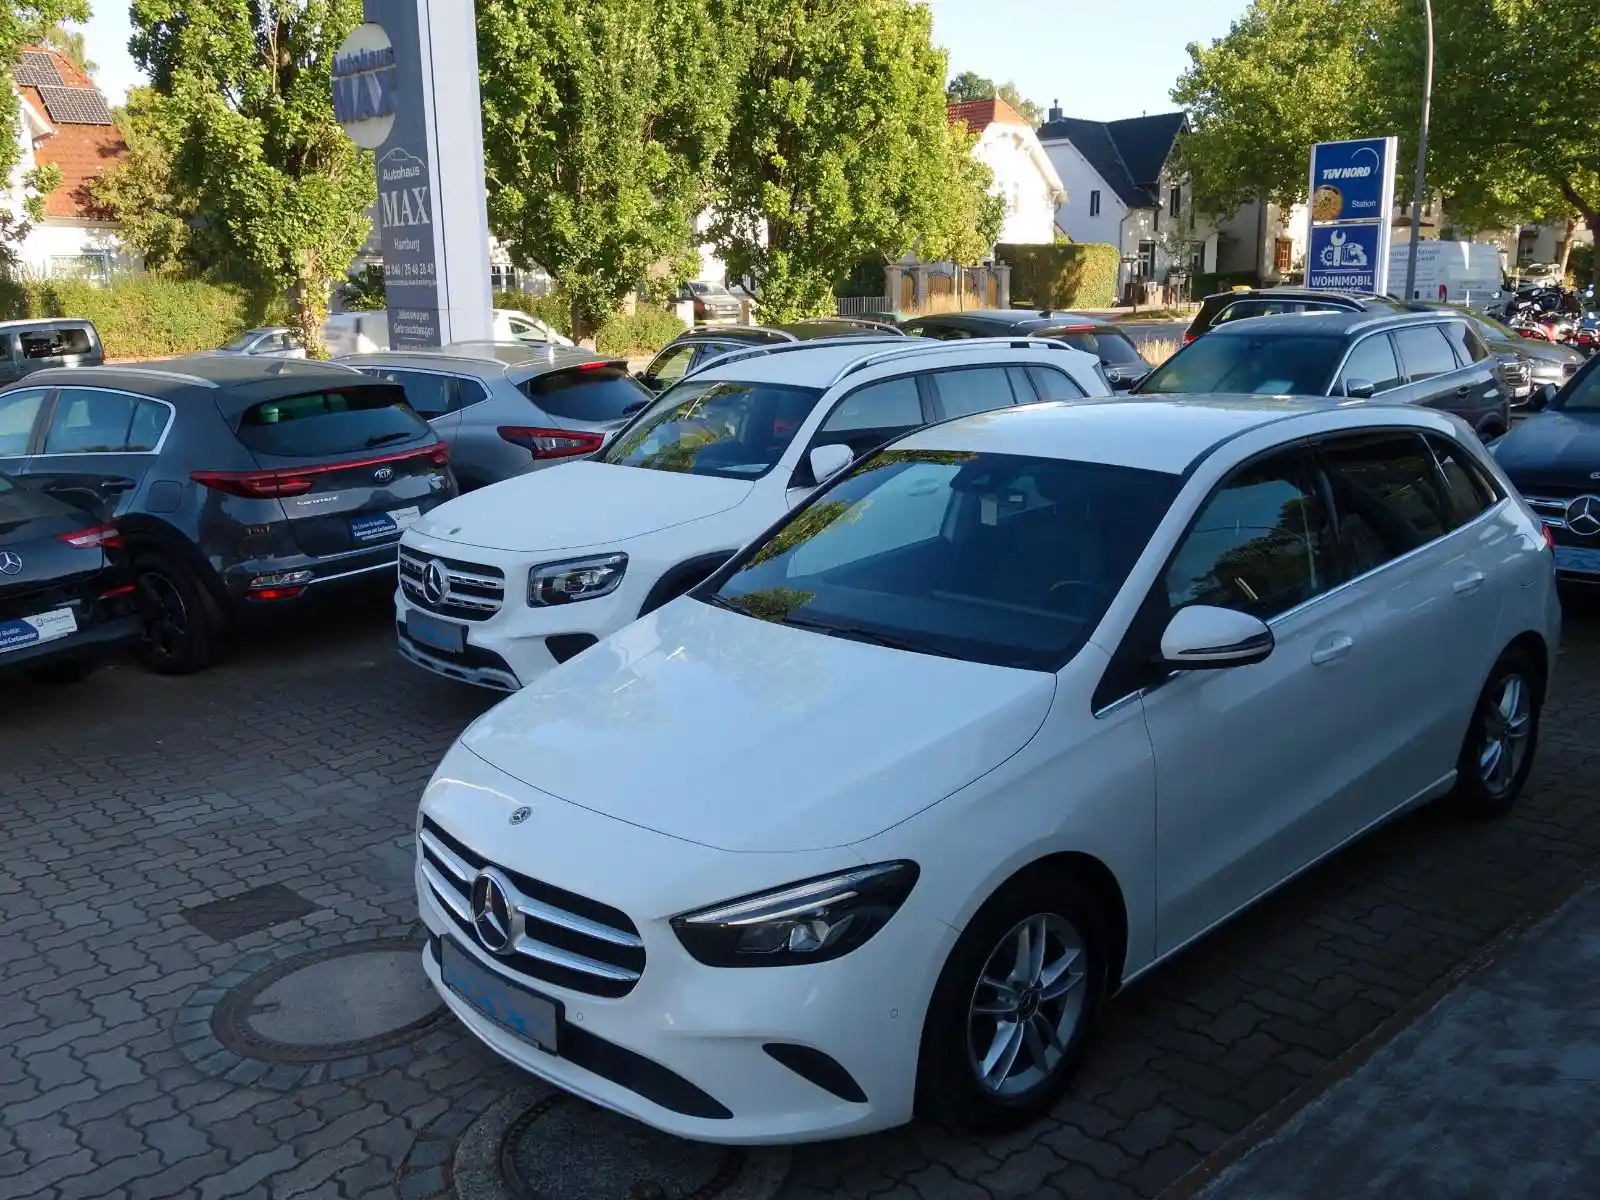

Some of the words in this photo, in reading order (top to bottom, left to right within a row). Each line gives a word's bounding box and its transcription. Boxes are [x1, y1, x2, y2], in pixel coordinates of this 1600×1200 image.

[383, 165, 420, 181] Autohaus
[1341, 167, 1371, 178] NORD
[380, 186, 431, 228] MAX
[1352, 199, 1376, 208] Station
[394, 236, 420, 252] Hamburg
[1312, 275, 1373, 287] WOHNMOBIL
